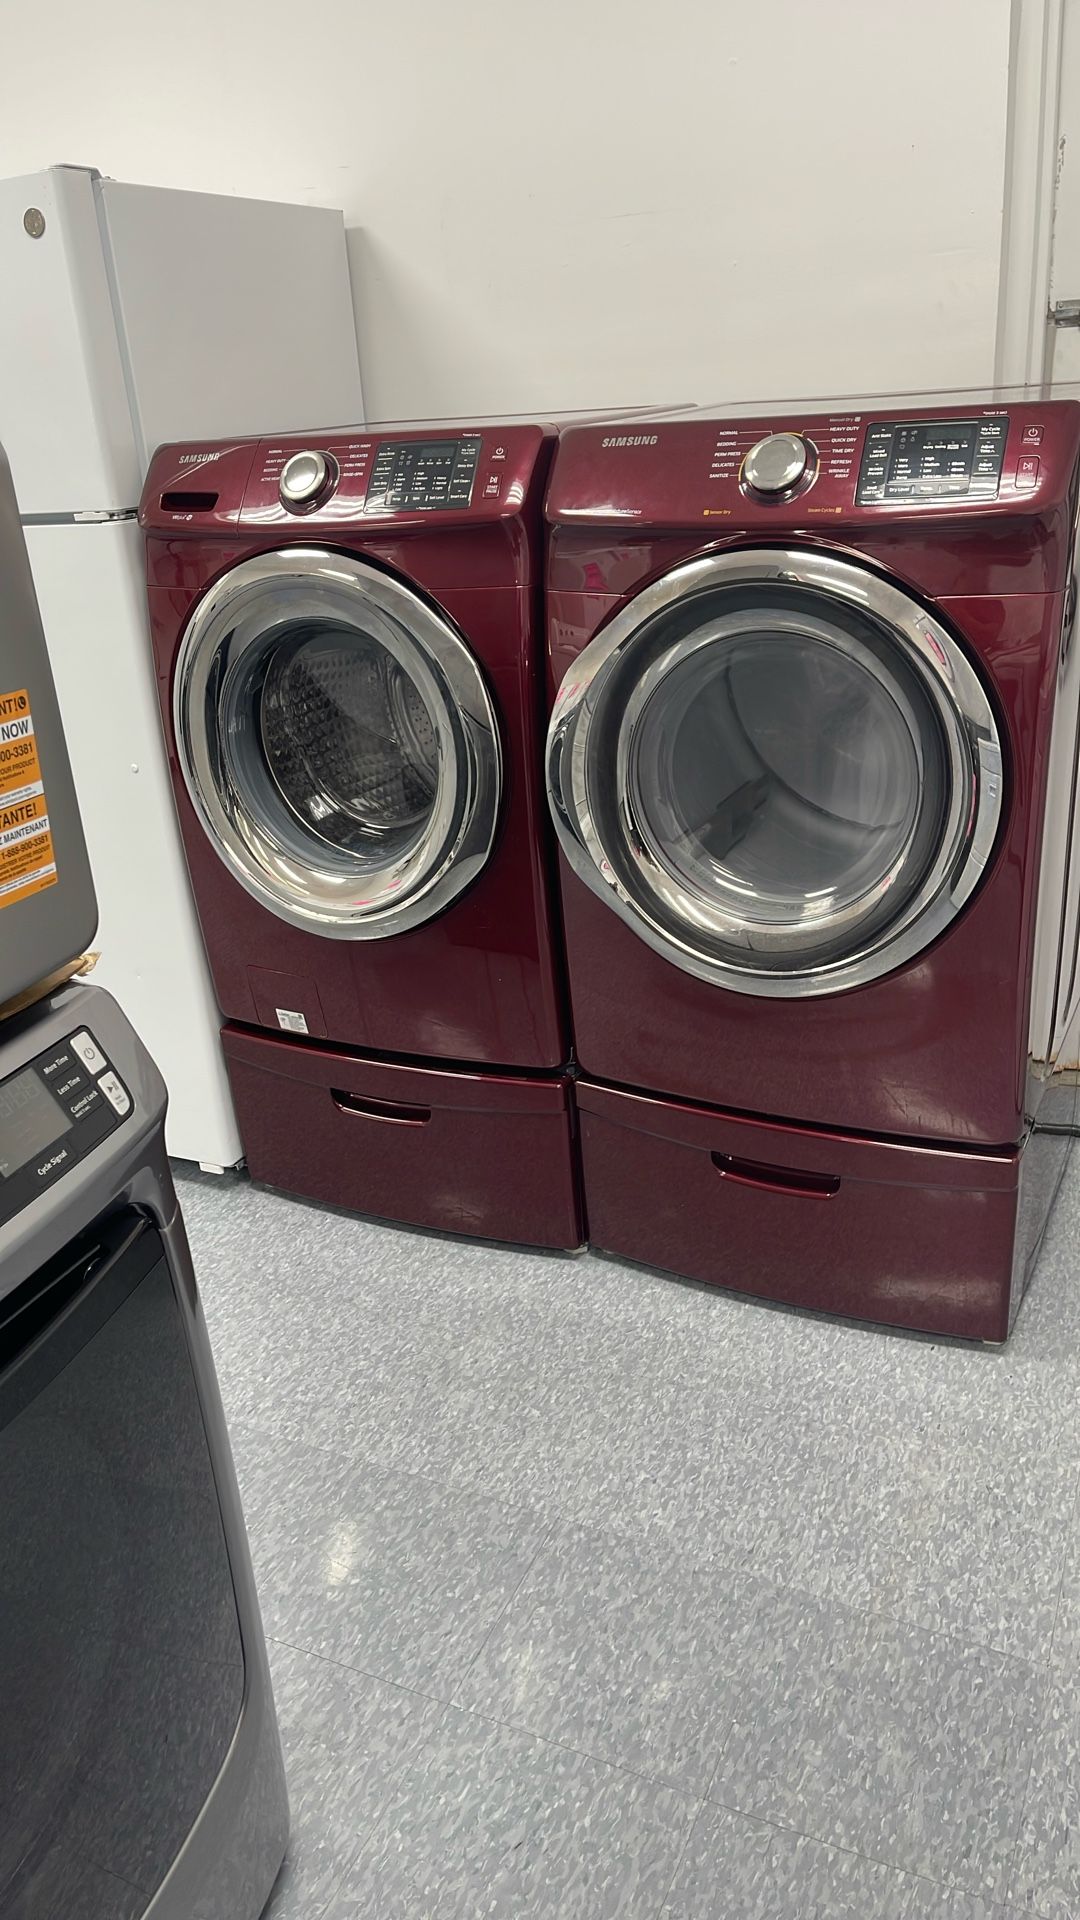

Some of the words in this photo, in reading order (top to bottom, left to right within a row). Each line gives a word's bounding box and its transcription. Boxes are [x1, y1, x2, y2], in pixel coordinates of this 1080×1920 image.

[602, 436, 658, 448] SAMSUNG
[178, 452, 220, 464] SAMSUNG
[2, 720, 28, 740] NOW
[0, 742, 33, 762] 00-3381
[4, 819, 47, 842] MAINTENANT
[43, 1063, 58, 1074] More
[55, 1056, 68, 1065] Time
[57, 1084, 70, 1095] Less
[67, 1076, 80, 1086] Time
[71, 1097, 88, 1113] Control
[86, 1090, 98, 1101] Lock
[38, 1160, 52, 1176] Cycle
[50, 1150, 68, 1166] Signal
